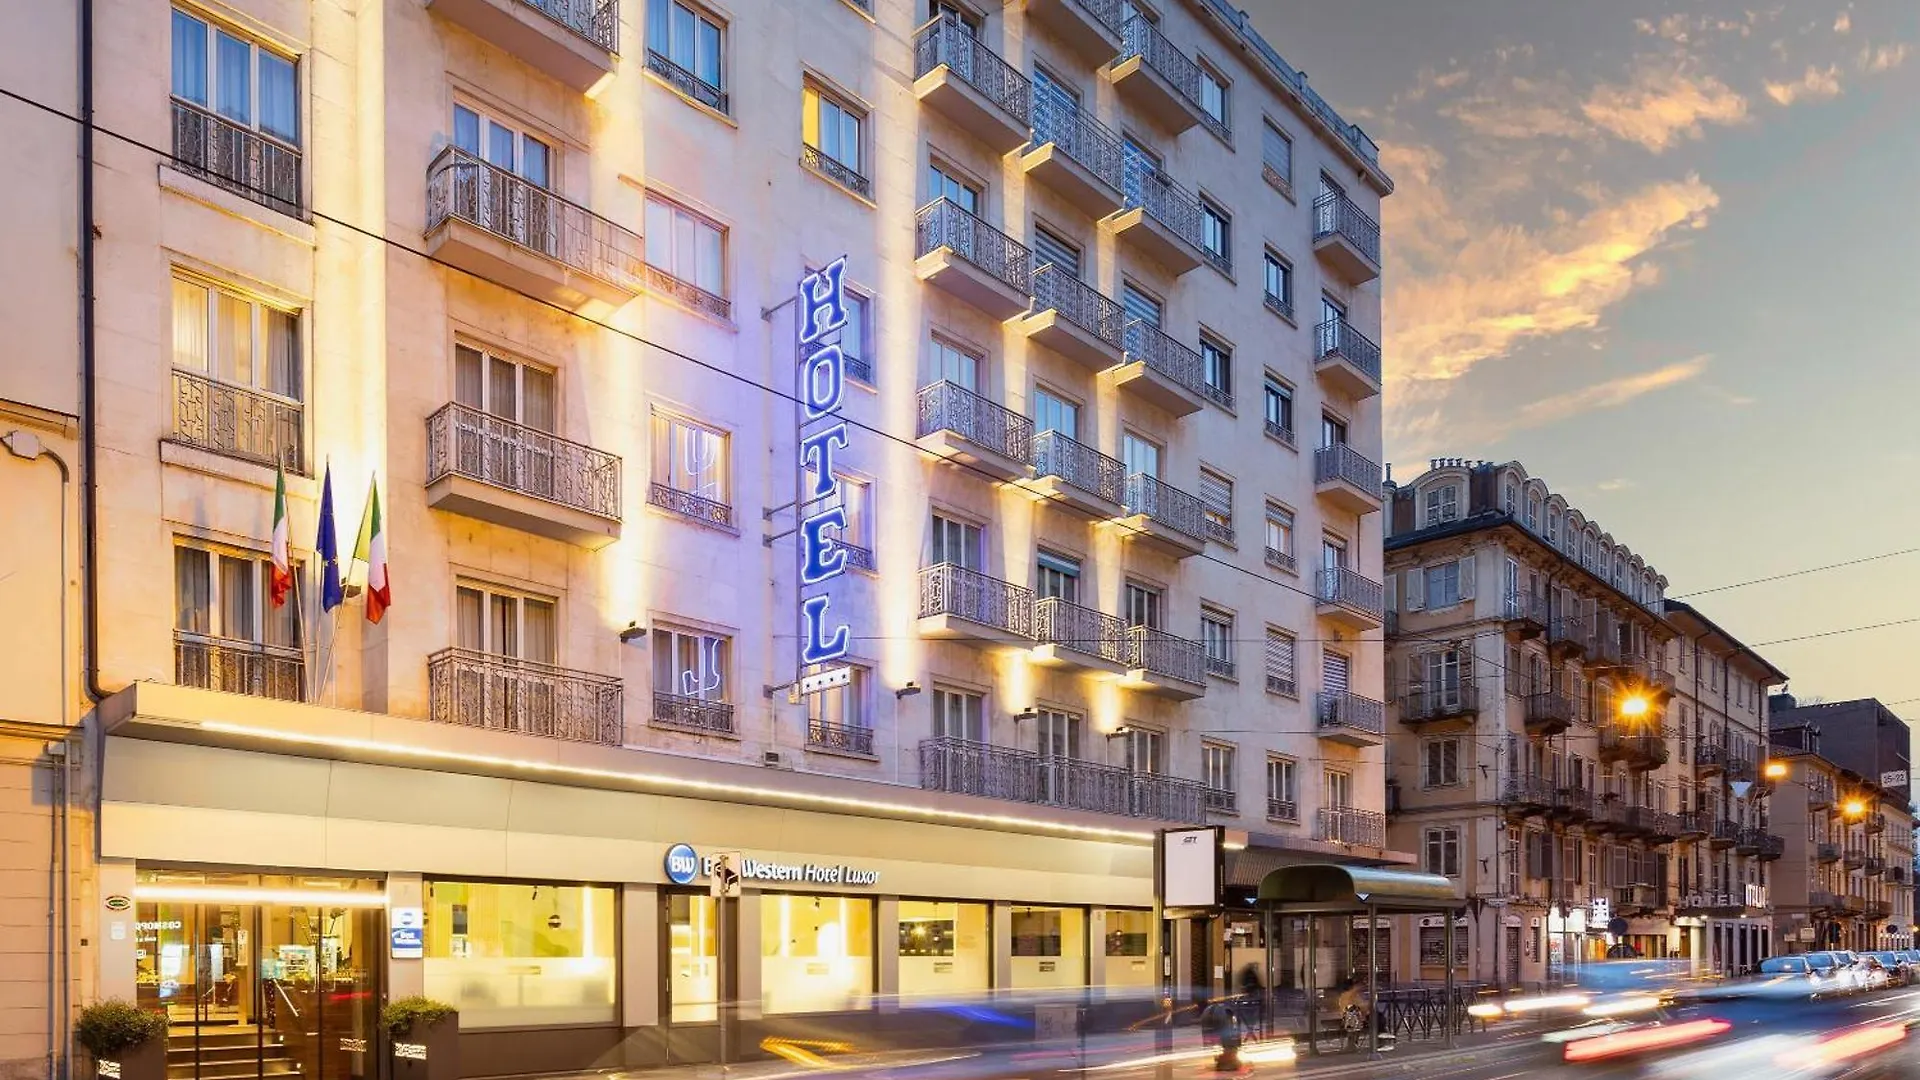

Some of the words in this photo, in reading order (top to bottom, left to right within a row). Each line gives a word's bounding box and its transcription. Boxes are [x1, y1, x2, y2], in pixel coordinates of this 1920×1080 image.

[799, 254, 849, 665] HOTEL
[671, 856, 695, 873] BW
[741, 859, 802, 880] Western
[803, 864, 842, 883] Hotel
[844, 866, 880, 885] Luxor
